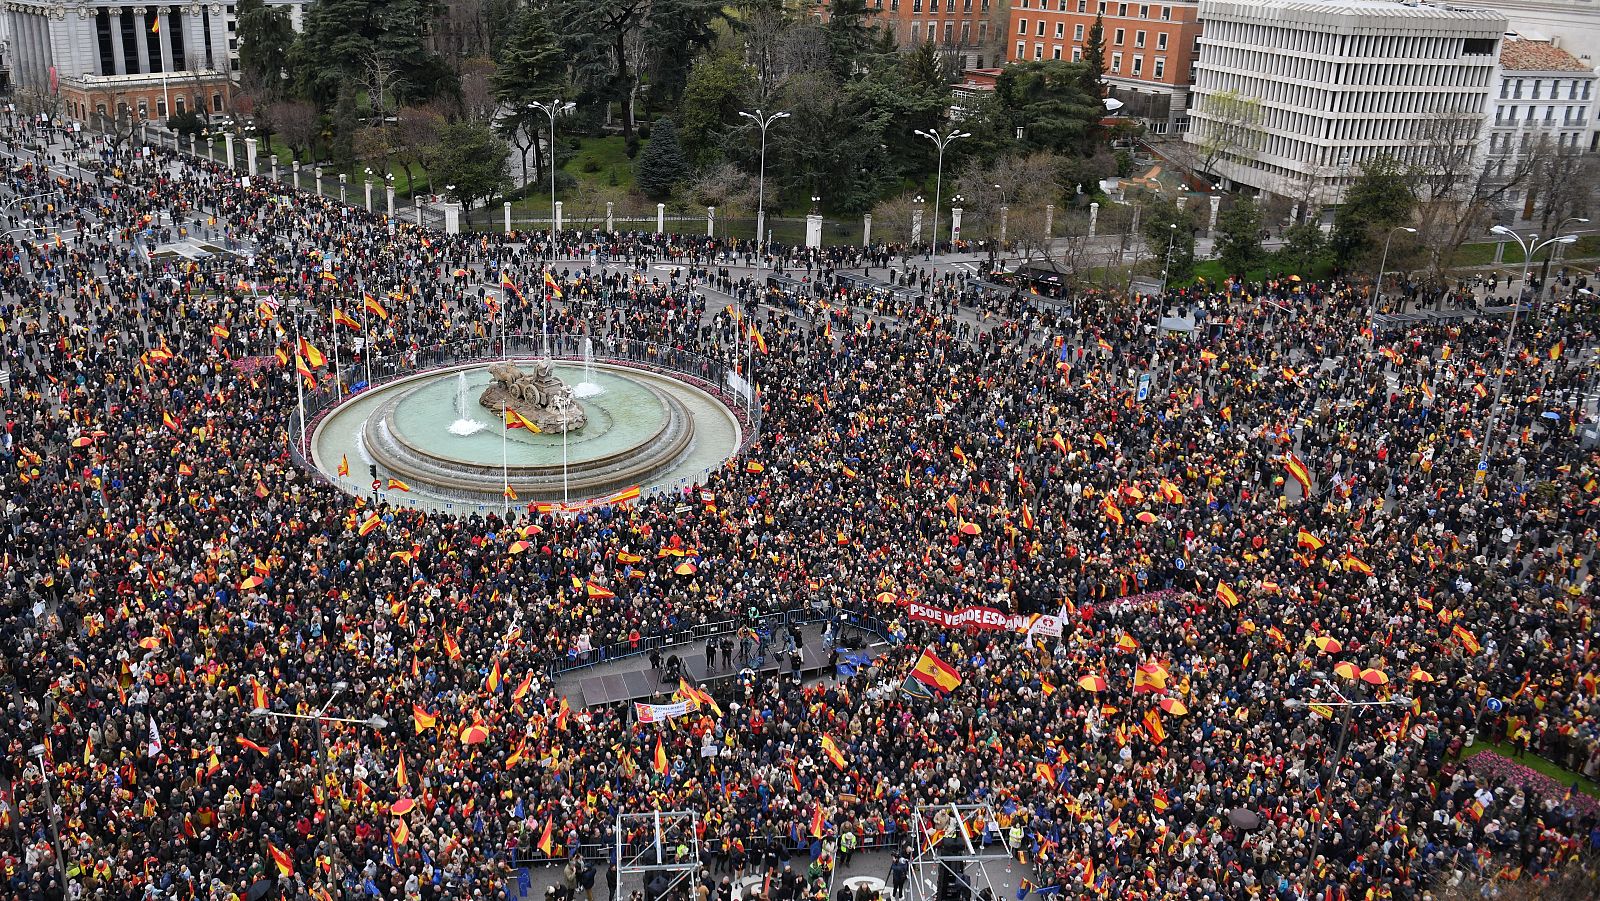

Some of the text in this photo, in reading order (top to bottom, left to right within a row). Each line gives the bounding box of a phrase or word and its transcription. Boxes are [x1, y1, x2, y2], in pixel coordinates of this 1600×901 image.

[910, 604, 1030, 630] PSOE VENDE ESPAÑA
